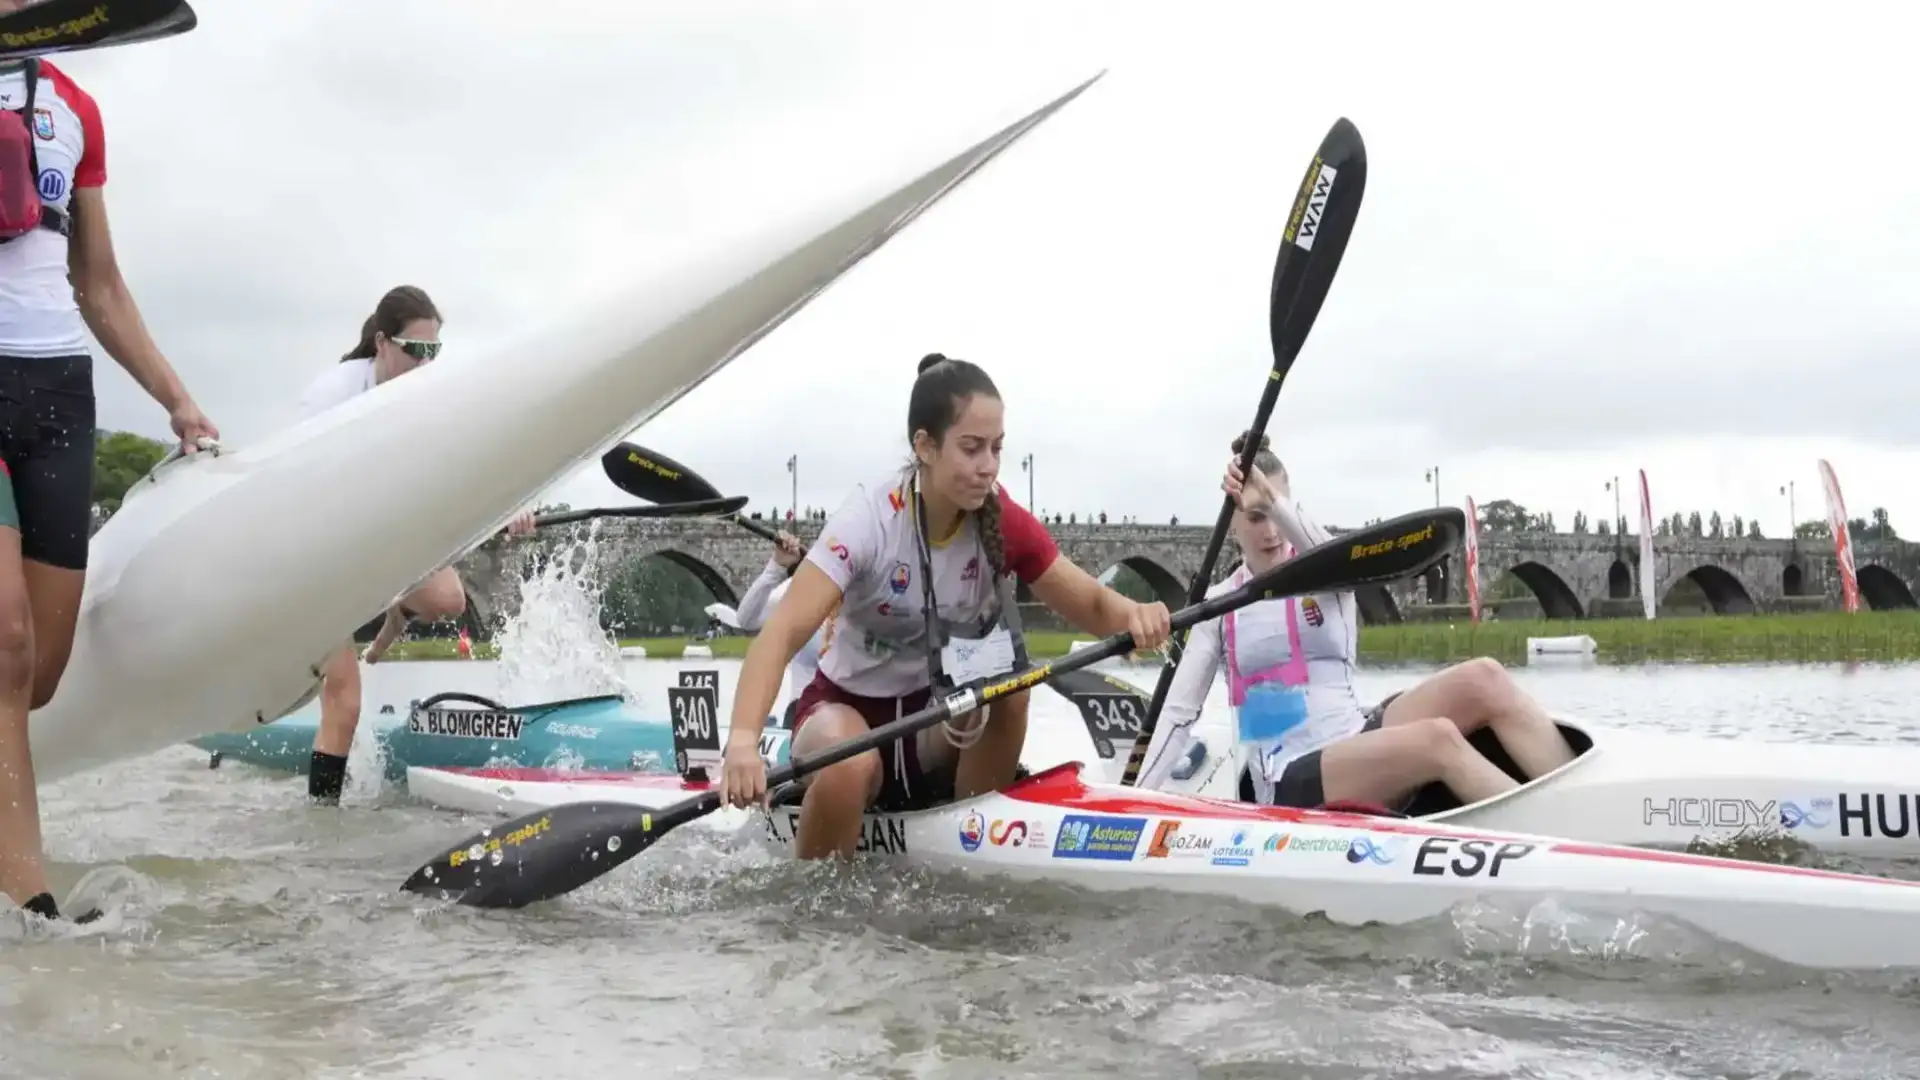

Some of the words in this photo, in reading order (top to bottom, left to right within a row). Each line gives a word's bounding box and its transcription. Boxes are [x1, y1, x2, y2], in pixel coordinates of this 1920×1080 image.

[1299, 174, 1330, 237] WAW
[411, 711, 425, 732] S.
[428, 711, 522, 739] BLOMGREN
[675, 696, 710, 740] 340
[1088, 698, 1142, 732] 343
[1091, 824, 1139, 842] Asturias
[1839, 793, 1920, 838] HU
[1289, 834, 1349, 852] Iberdrola
[1413, 837, 1536, 877] ESP
